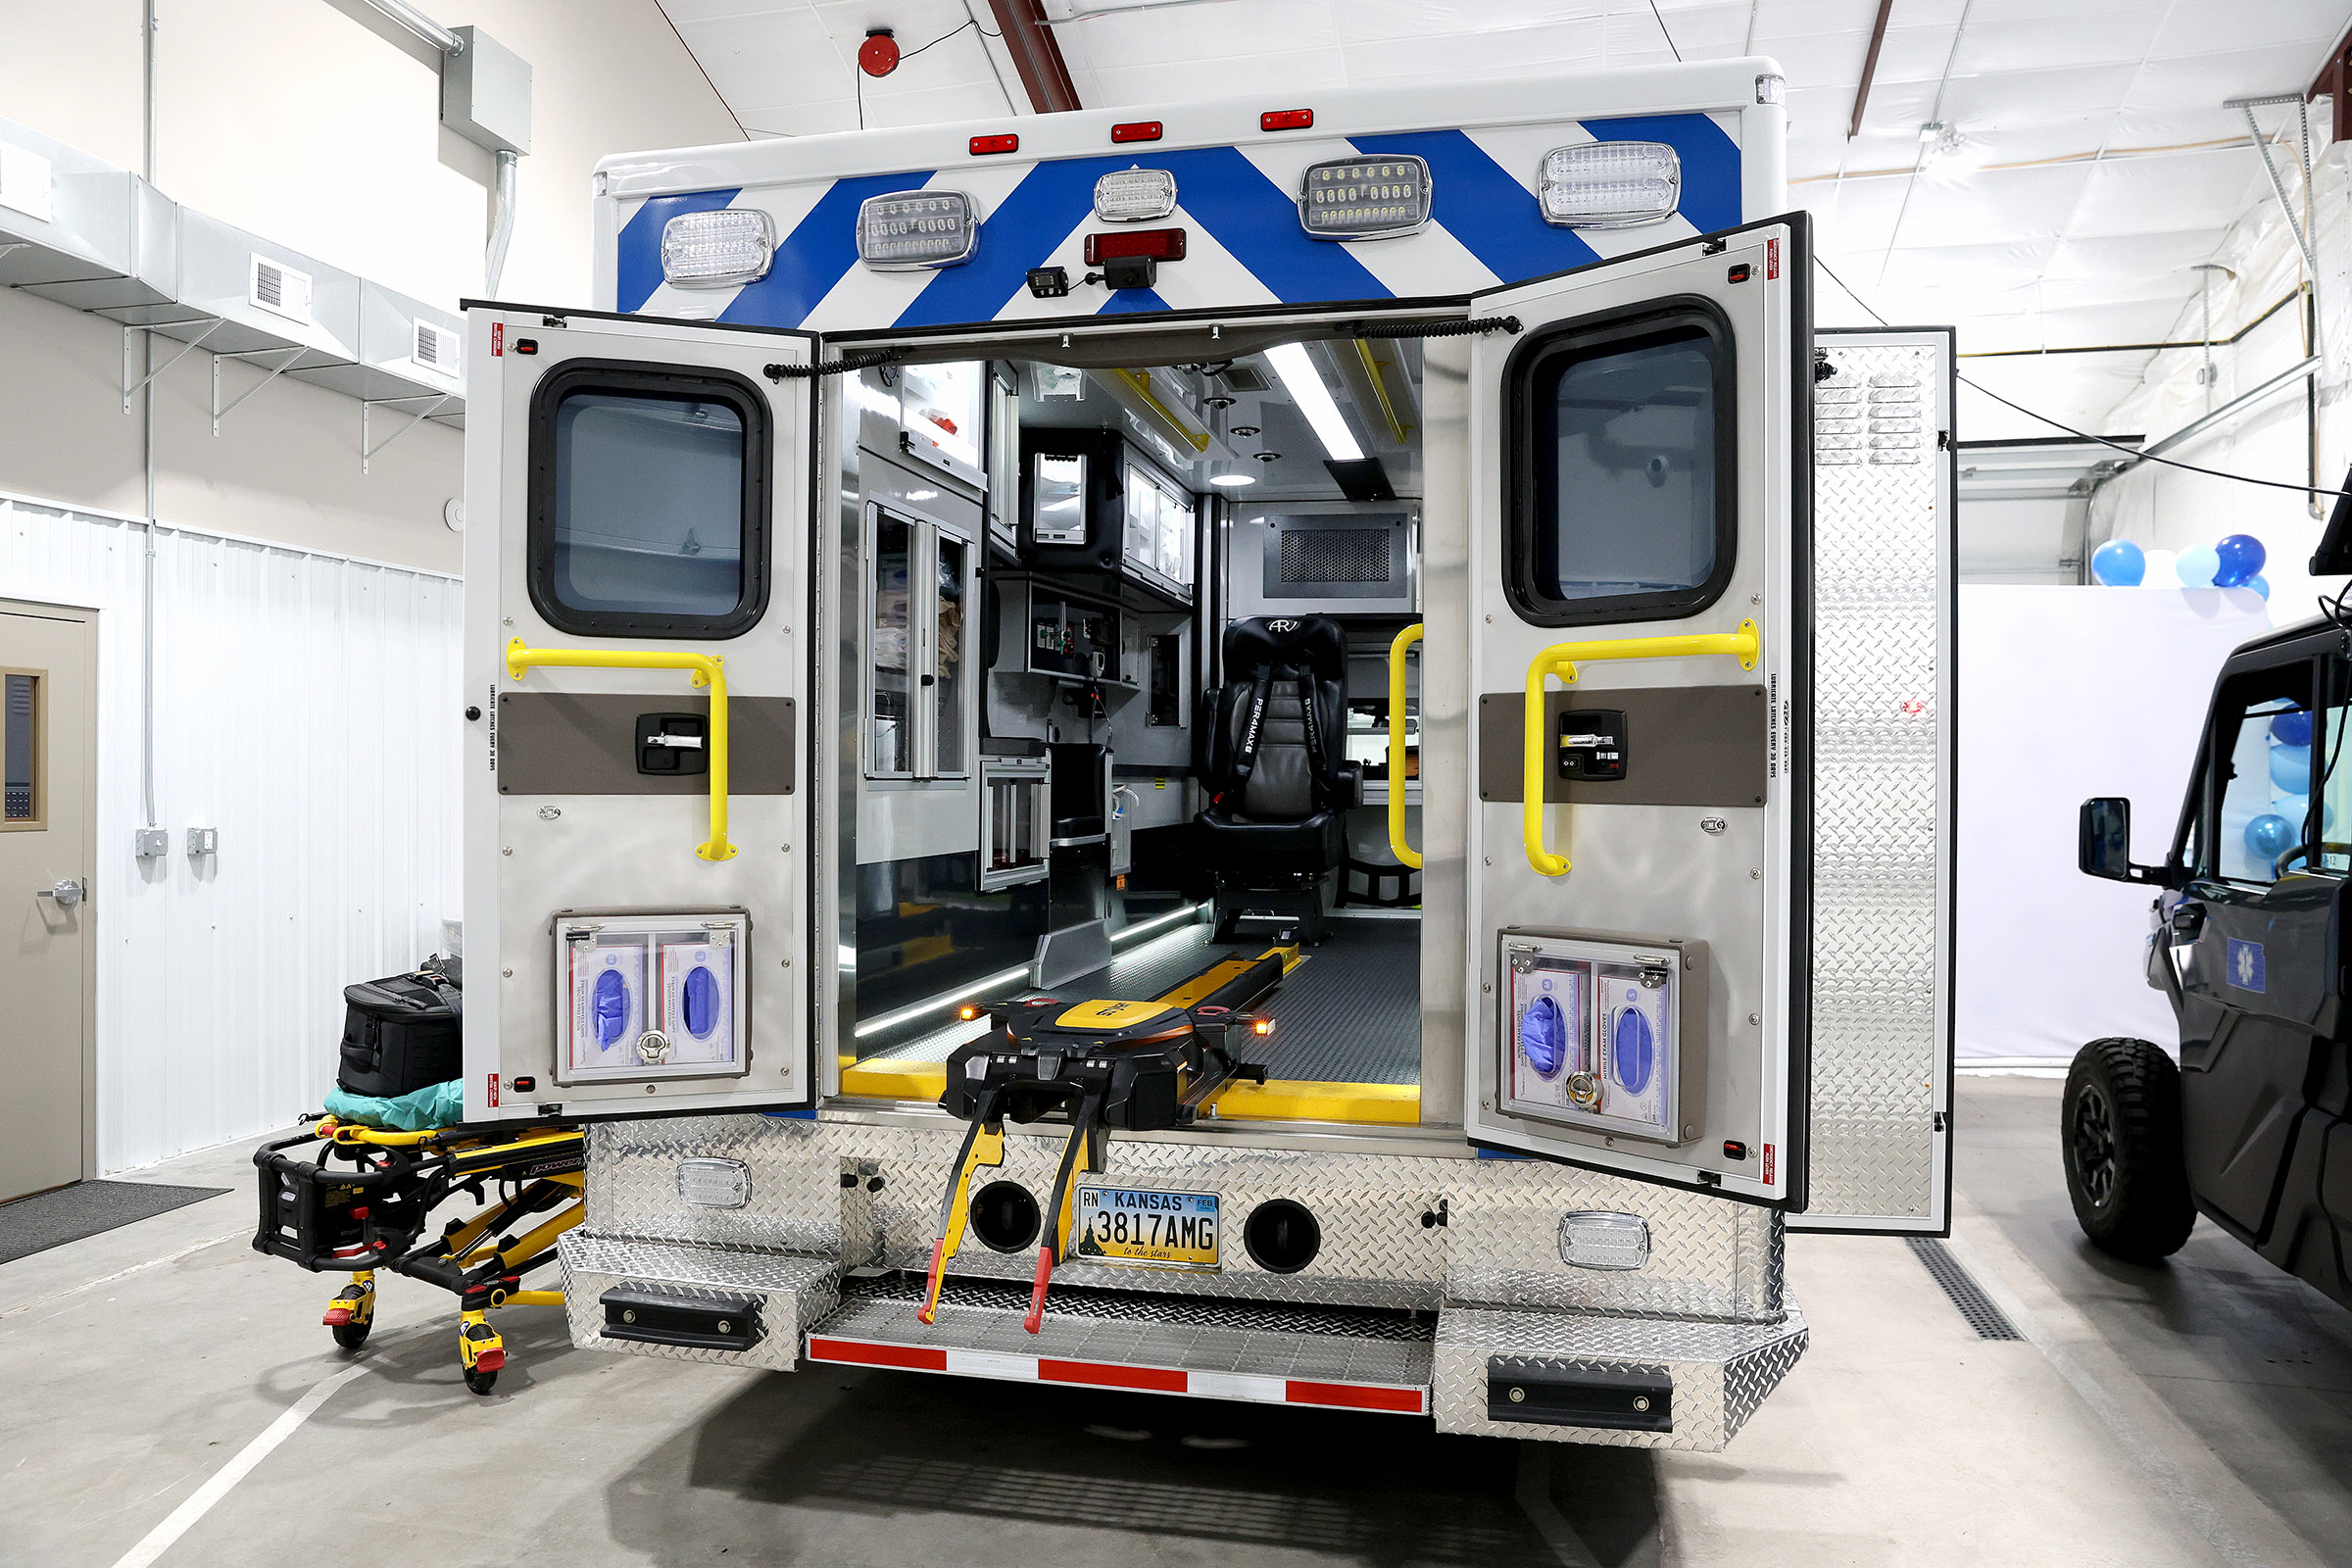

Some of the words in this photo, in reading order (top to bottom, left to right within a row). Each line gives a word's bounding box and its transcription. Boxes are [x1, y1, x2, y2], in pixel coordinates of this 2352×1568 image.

[1246, 697, 1264, 747] PER4MAX
[1305, 705, 1317, 754] PER4MAX
[529, 1156, 581, 1176] power
[1083, 1192, 1099, 1207] RN
[1114, 1192, 1182, 1211] KANSAS
[1197, 1199, 1213, 1207] FEB
[1097, 1210, 1213, 1250] 3817AMG
[1124, 1247, 1132, 1255] to
[1135, 1247, 1149, 1257] the
[1151, 1249, 1171, 1259] stars
